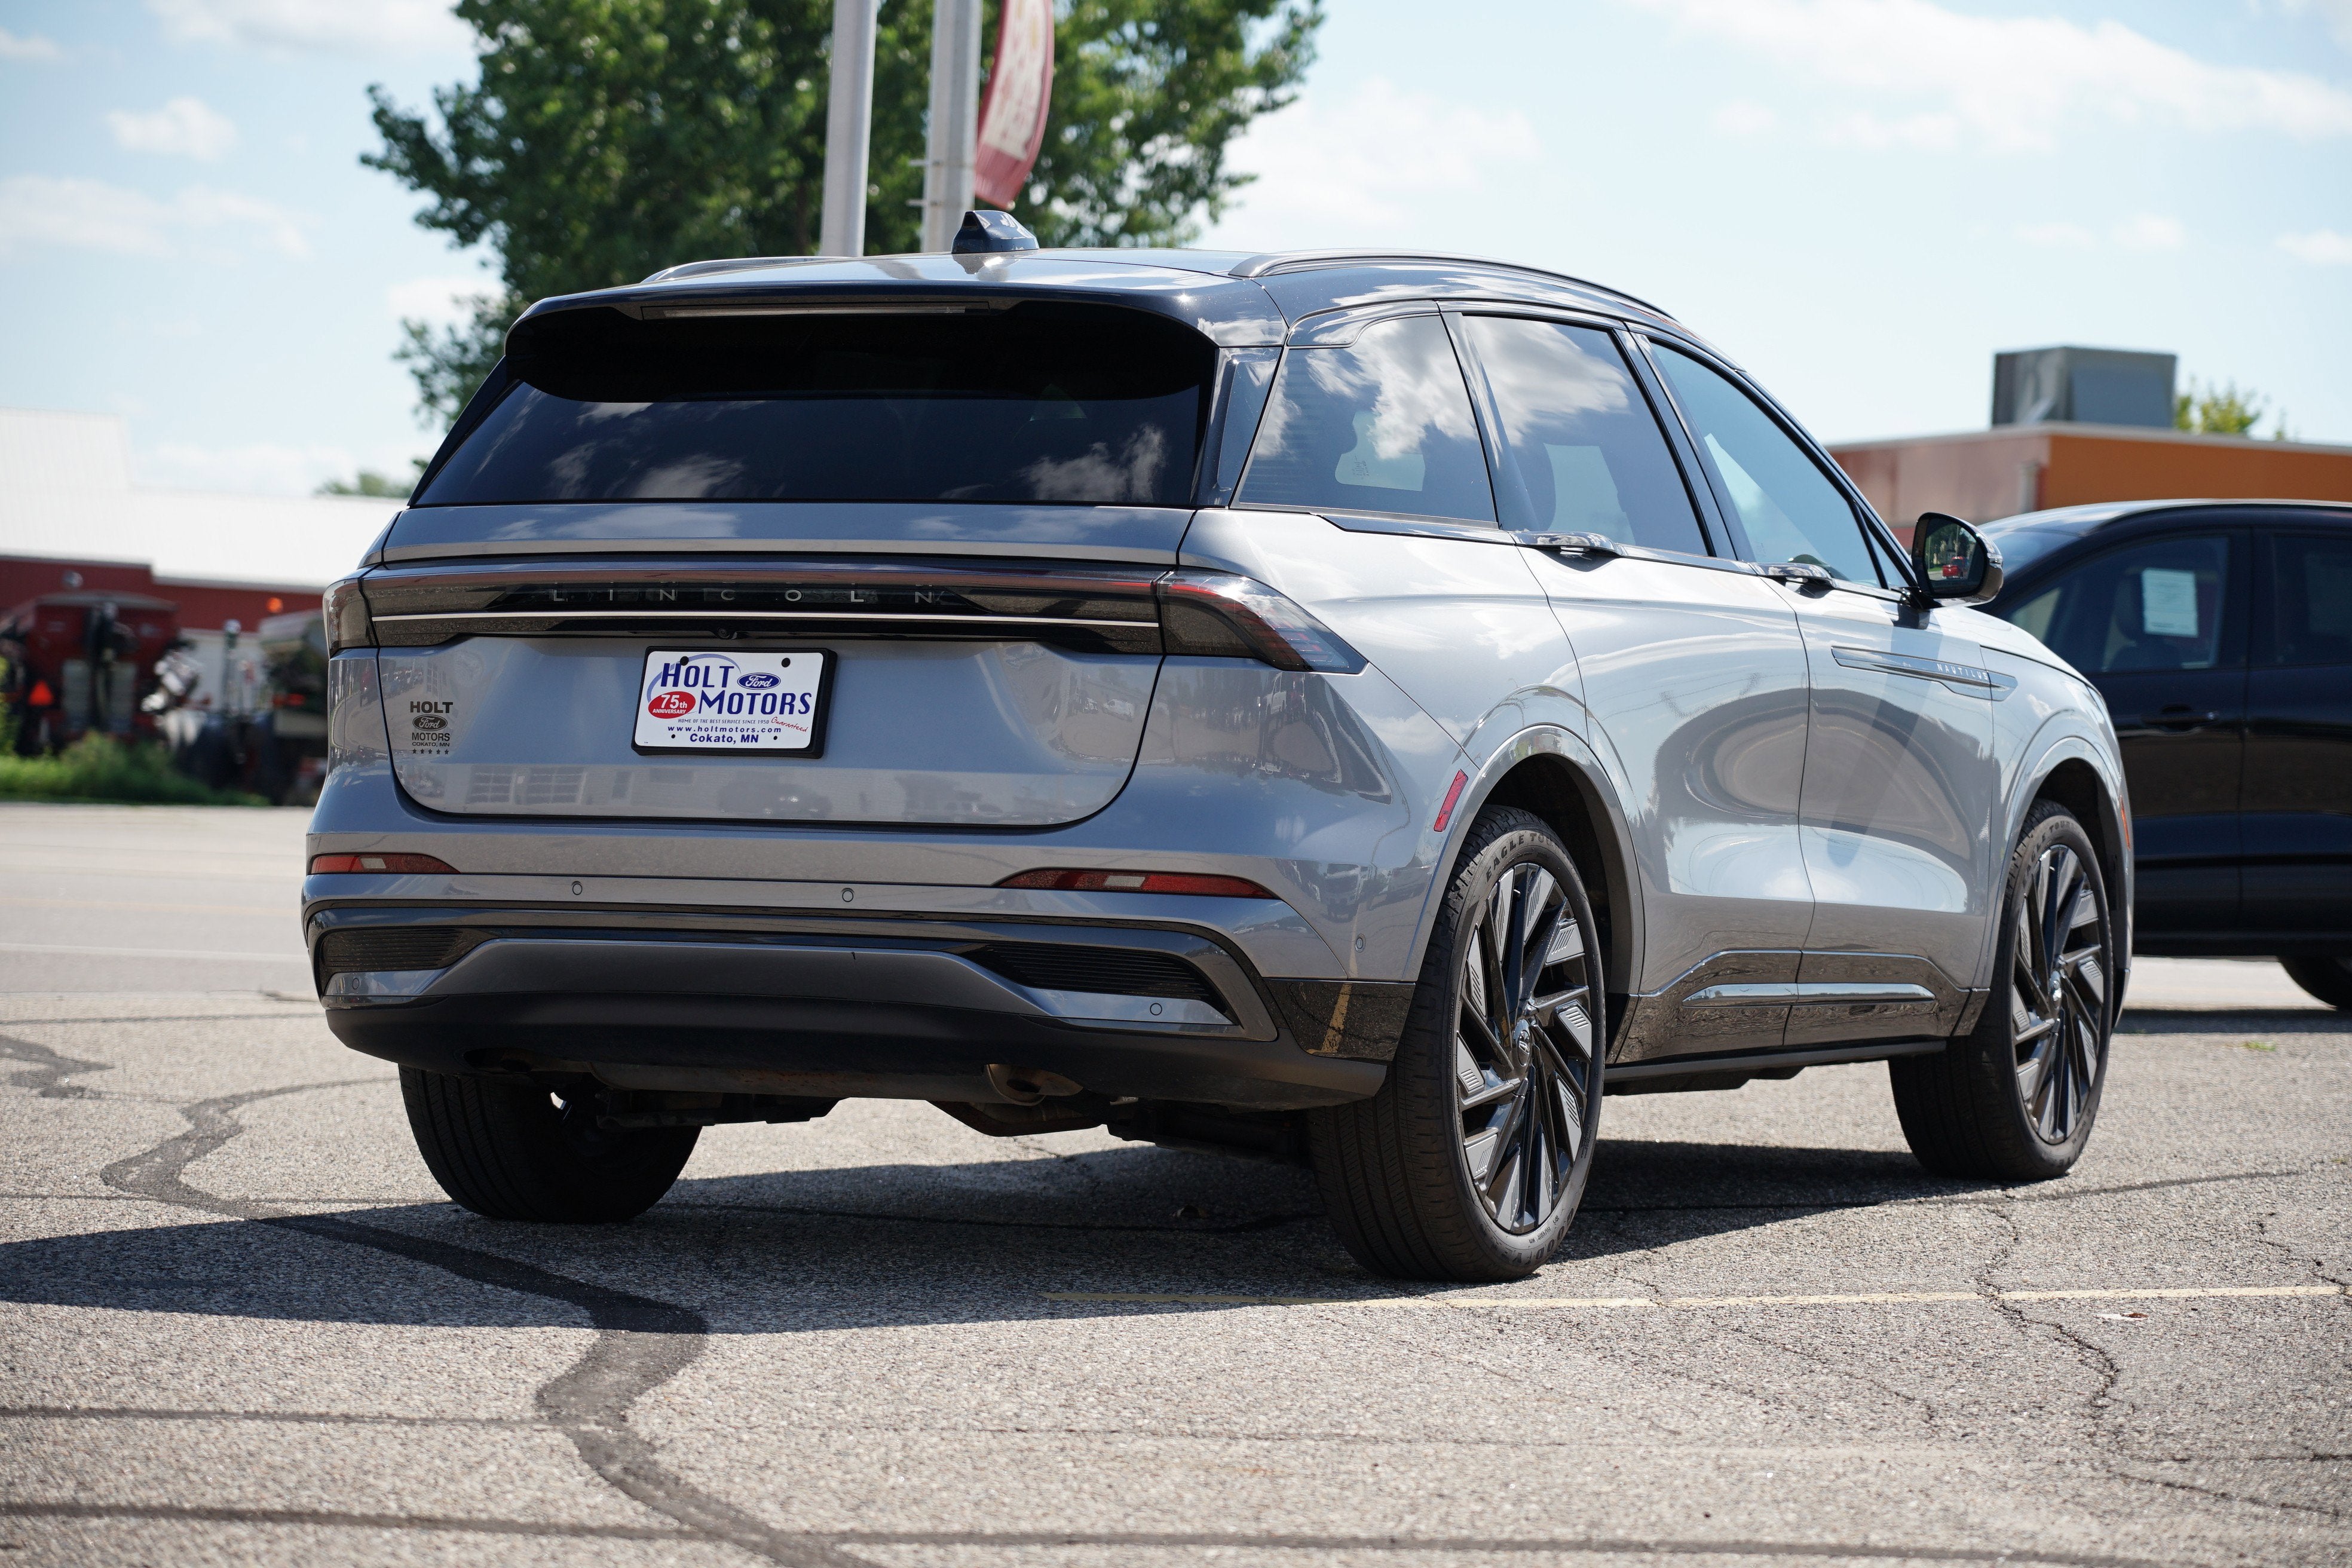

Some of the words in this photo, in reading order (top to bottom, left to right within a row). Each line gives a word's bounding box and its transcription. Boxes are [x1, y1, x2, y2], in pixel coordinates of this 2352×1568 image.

[553, 589, 932, 604] LINCOLN
[660, 663, 734, 688] HOLT
[1937, 663, 1988, 681] NAUTILUS
[745, 675, 773, 687] Ford
[410, 701, 454, 713] HOLT
[661, 694, 688, 709] 75th
[699, 690, 812, 715] MOTORS
[419, 716, 440, 728] Ford
[771, 716, 808, 732] Guaranteed
[412, 732, 451, 741] MOTORS
[690, 733, 736, 745] Cokato,
[740, 734, 759, 743] MN
[1486, 835, 1524, 882] EAGLE
